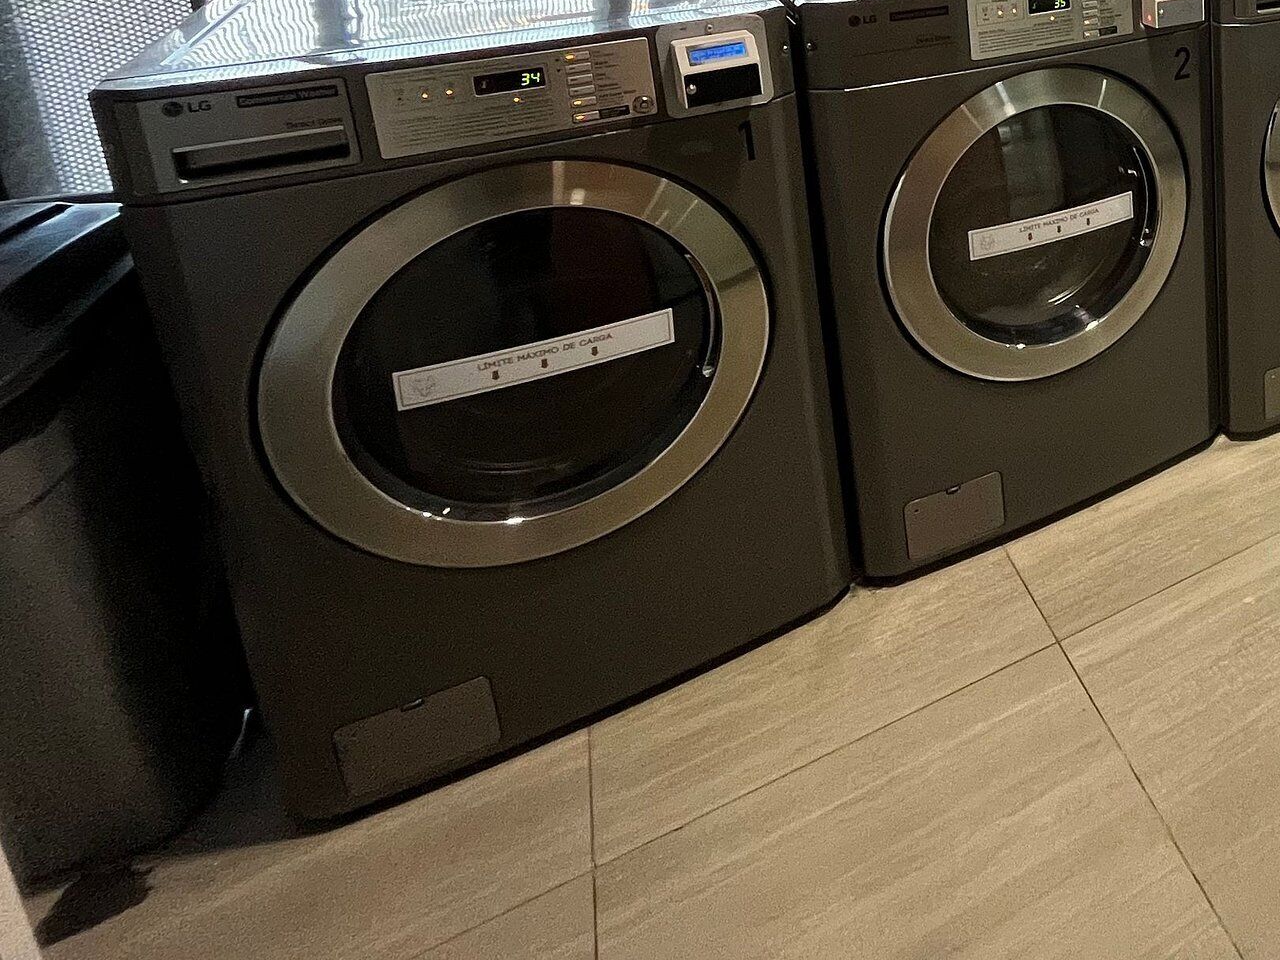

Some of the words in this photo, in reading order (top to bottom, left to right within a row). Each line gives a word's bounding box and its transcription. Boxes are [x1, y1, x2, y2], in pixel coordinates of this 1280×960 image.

[863, 15, 877, 24] LG
[1174, 47, 1192, 81] 2
[521, 72, 541, 86] 34
[187, 100, 211, 112] LG
[738, 120, 756, 160] 1
[563, 341, 577, 351] DE
[579, 332, 613, 347] CARGA
